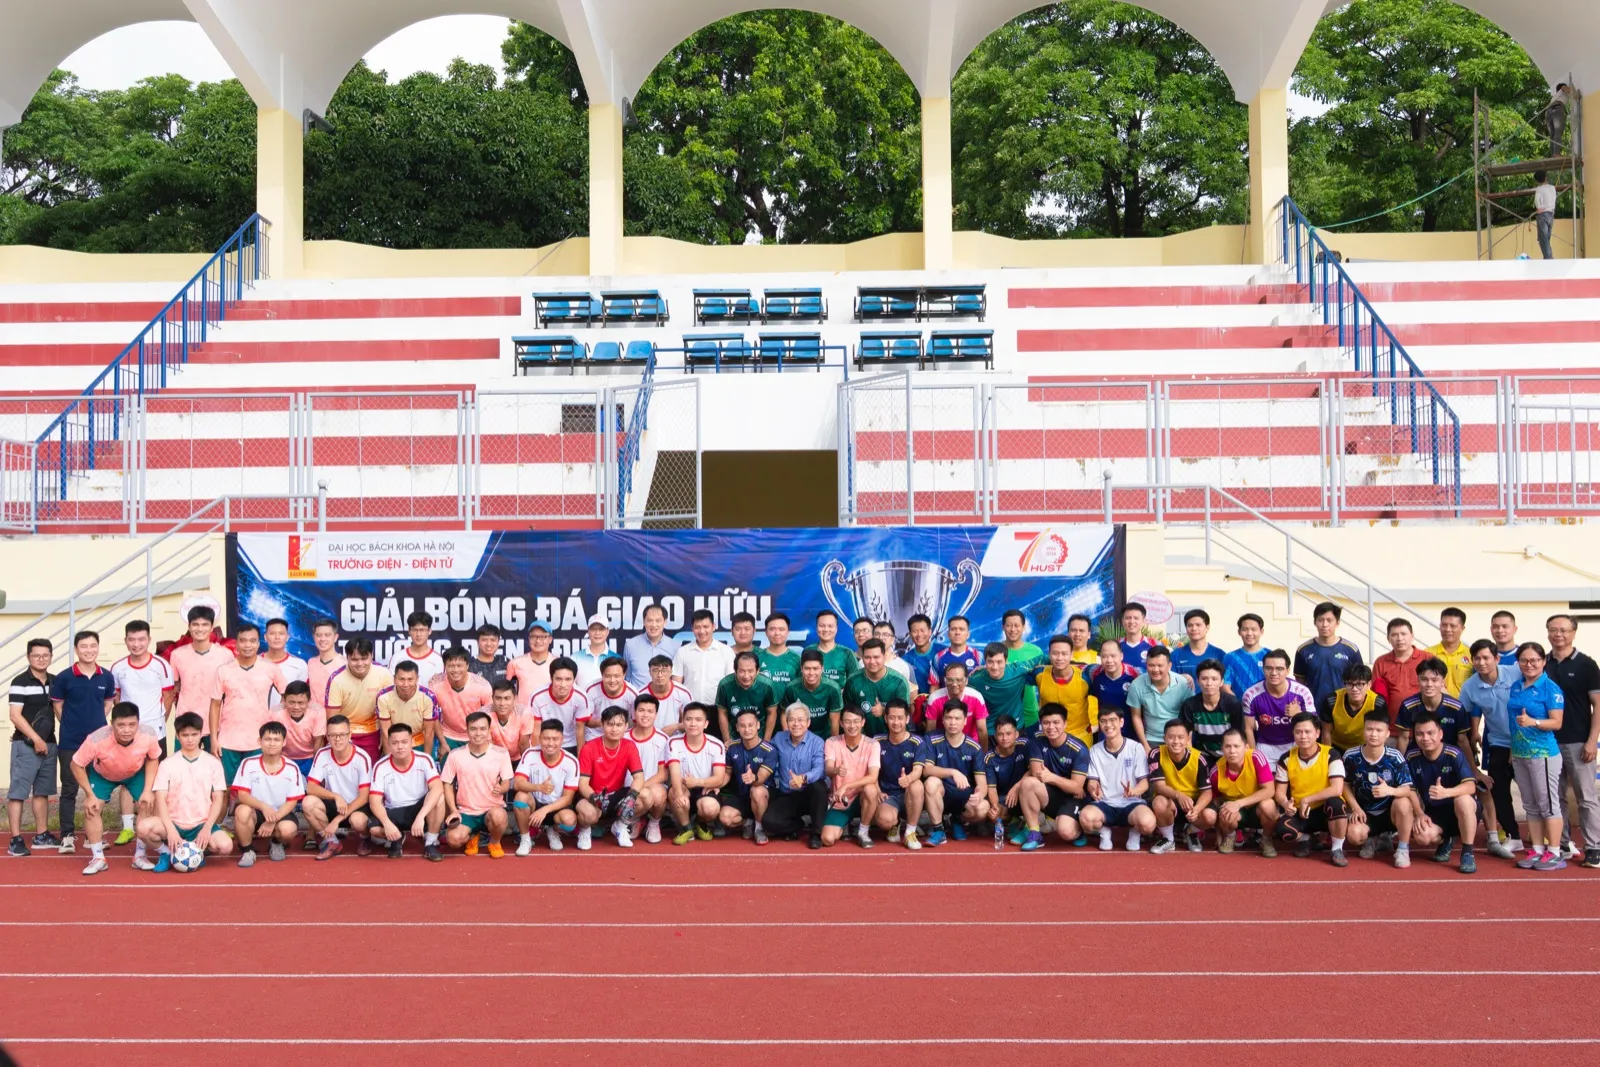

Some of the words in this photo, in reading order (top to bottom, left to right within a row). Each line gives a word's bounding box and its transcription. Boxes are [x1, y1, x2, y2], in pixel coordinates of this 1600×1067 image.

[328, 543, 344, 554] ĐẠI
[346, 543, 366, 554] HỌC
[369, 541, 394, 552] BÁCH
[396, 542, 421, 551] KHOA
[423, 540, 437, 551] HÀ
[438, 541, 455, 552] NỘI
[328, 557, 374, 569] TRƯỜNG
[377, 557, 401, 571] ĐIỆN
[412, 557, 437, 571] ĐIỆN
[440, 556, 454, 568] TỬ
[1031, 564, 1063, 572] HUST
[425, 588, 526, 632] BÓNG
[534, 588, 588, 631] ĐÁ
[693, 587, 771, 630] HỮU
[1273, 715, 1292, 725] SC
